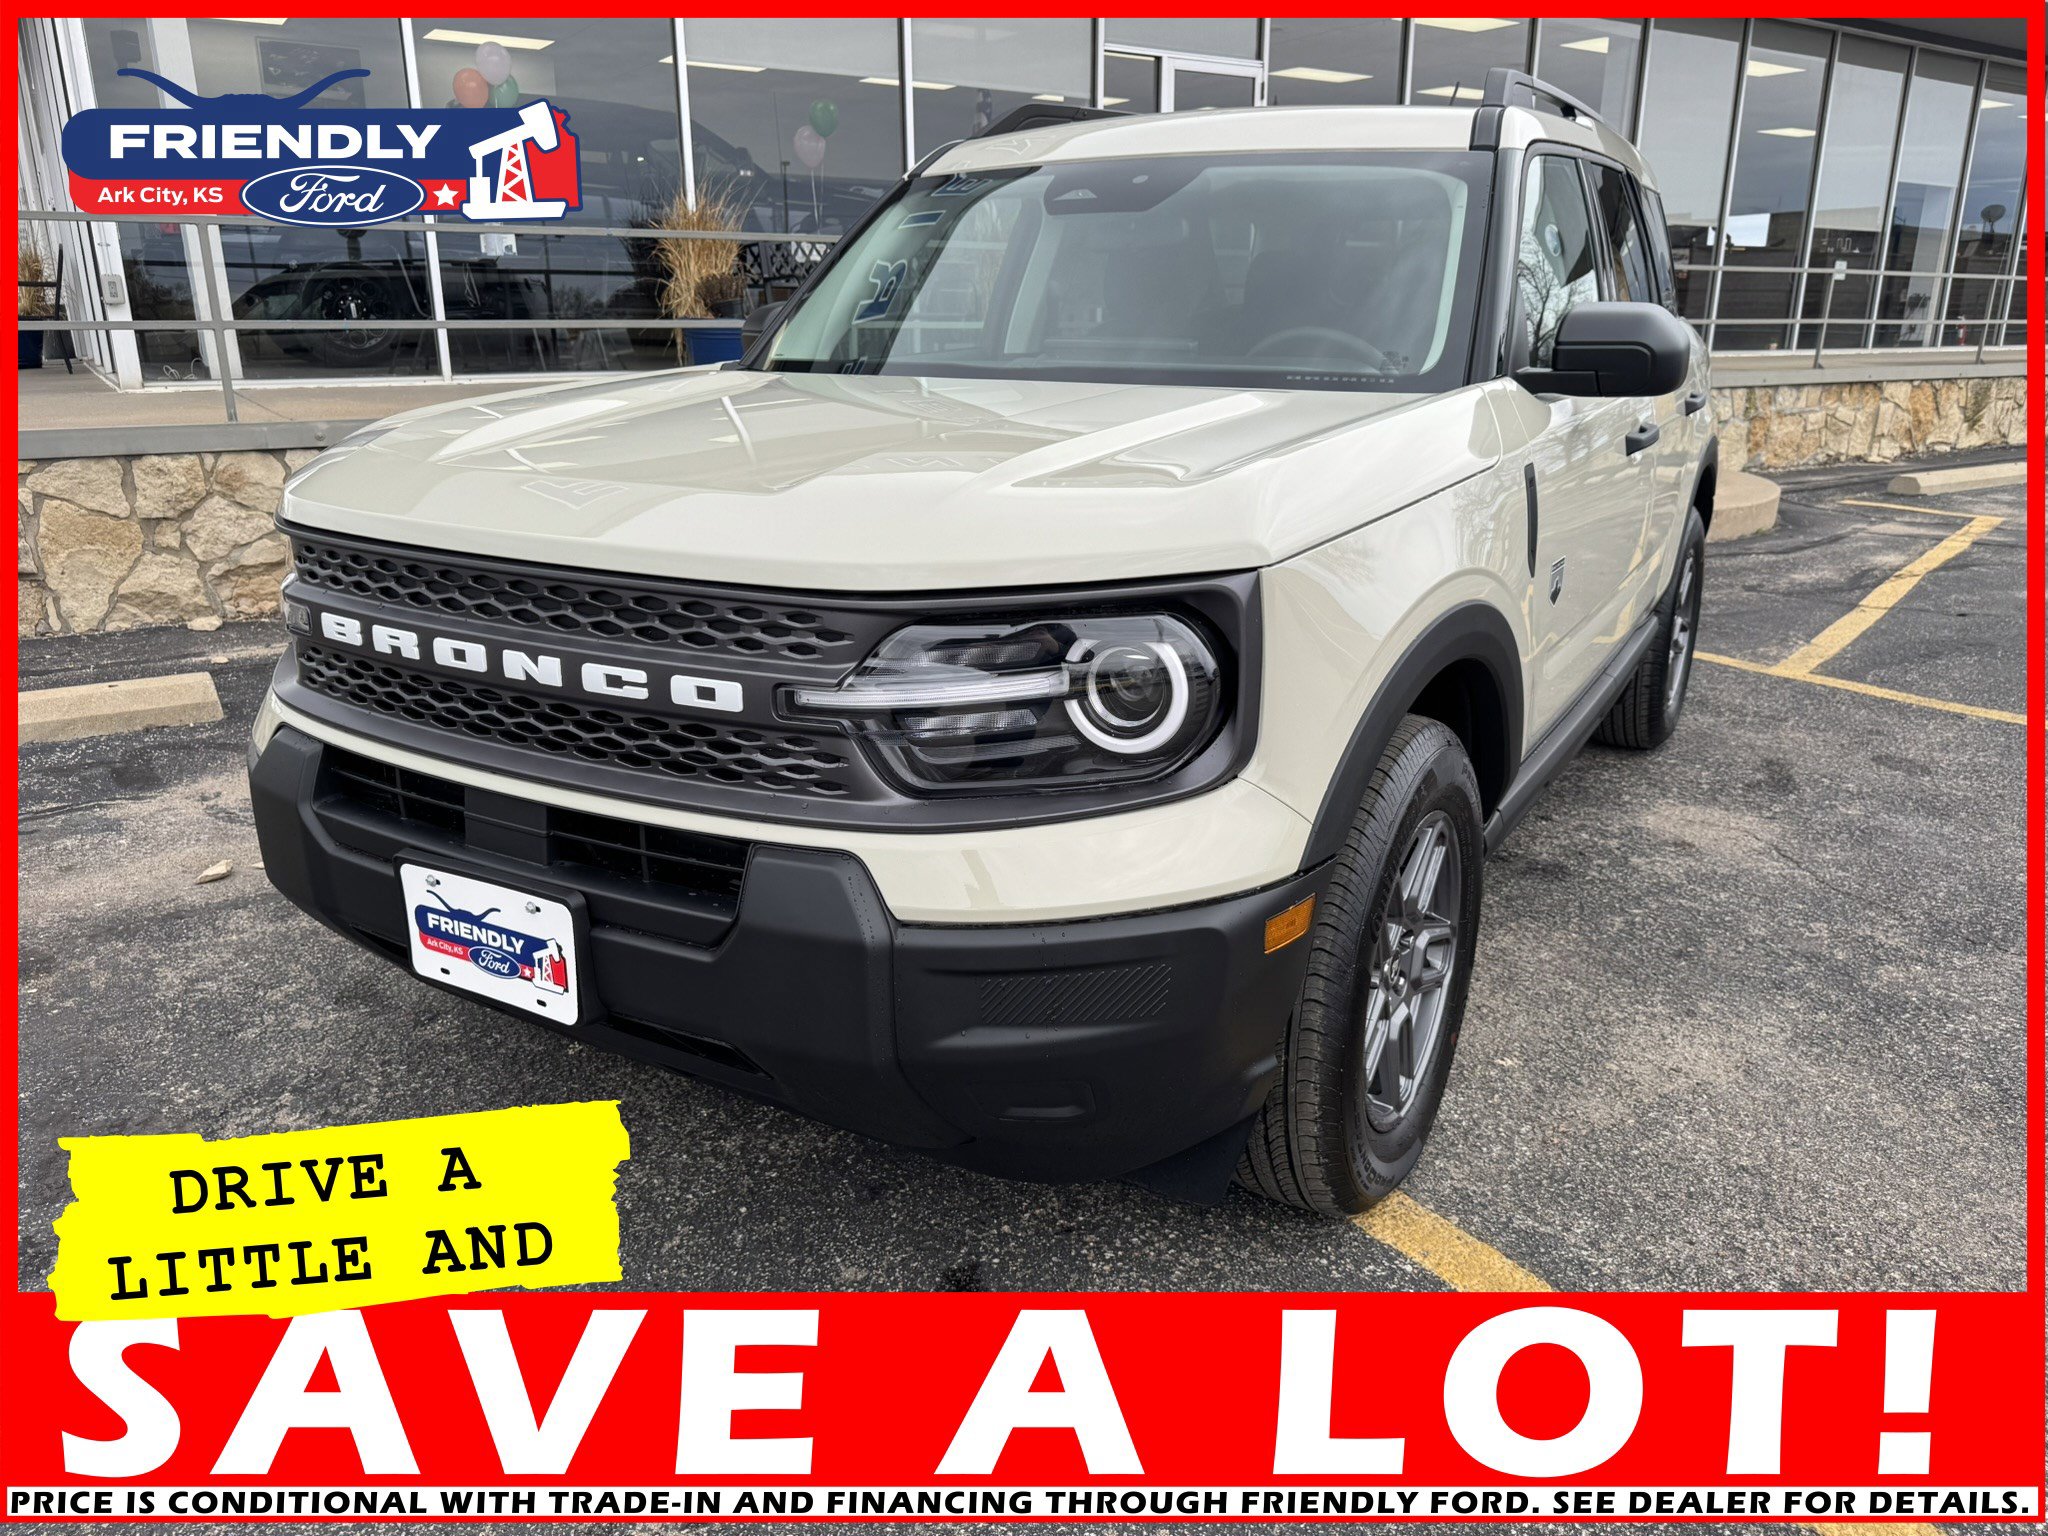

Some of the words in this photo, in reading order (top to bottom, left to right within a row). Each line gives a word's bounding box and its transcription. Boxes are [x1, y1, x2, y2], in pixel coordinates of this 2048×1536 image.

[320, 611, 744, 713] BRONCO
[427, 913, 524, 954] FRIENDLY
[427, 938, 439, 948] Ark
[453, 946, 464, 955] KS
[478, 949, 510, 973] Ford
